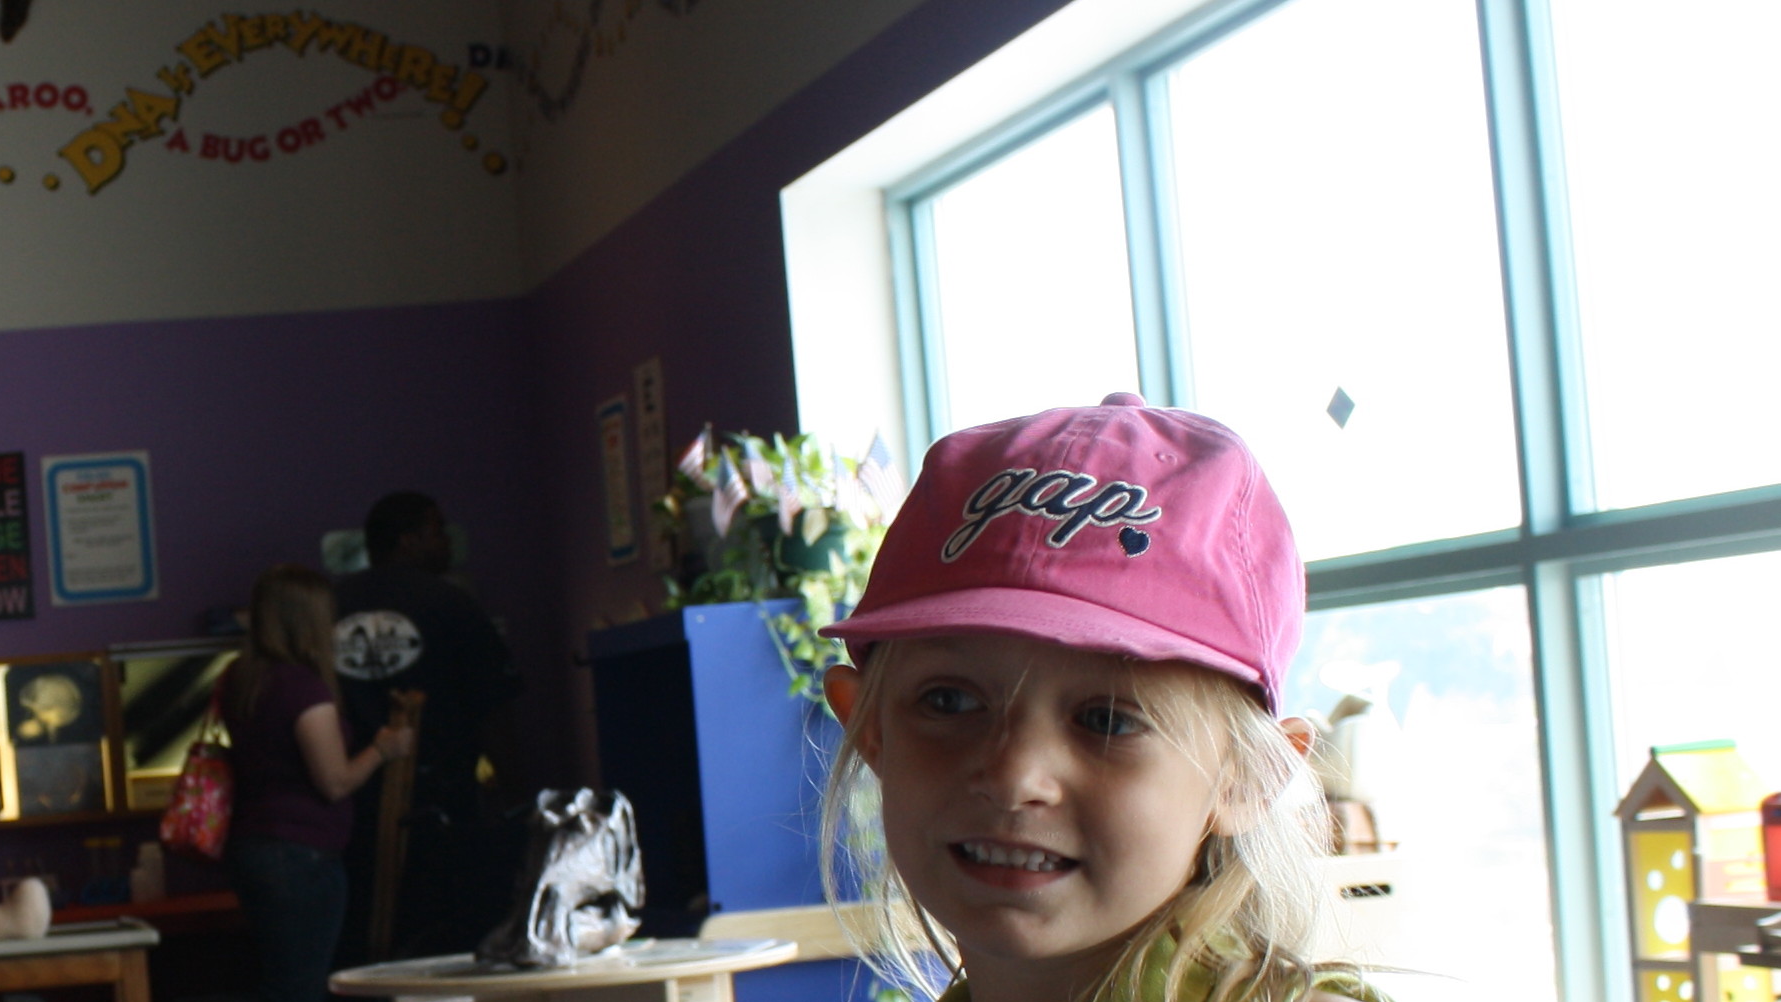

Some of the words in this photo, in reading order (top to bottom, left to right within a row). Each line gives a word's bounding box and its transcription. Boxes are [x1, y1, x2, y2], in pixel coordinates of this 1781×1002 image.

[57, 87, 181, 196] DNA
[175, 9, 488, 131] EVERYWHERE!
[165, 127, 191, 154] A
[198, 132, 271, 164] BUG
[276, 116, 326, 155] OR
[941, 467, 1162, 563] gap
